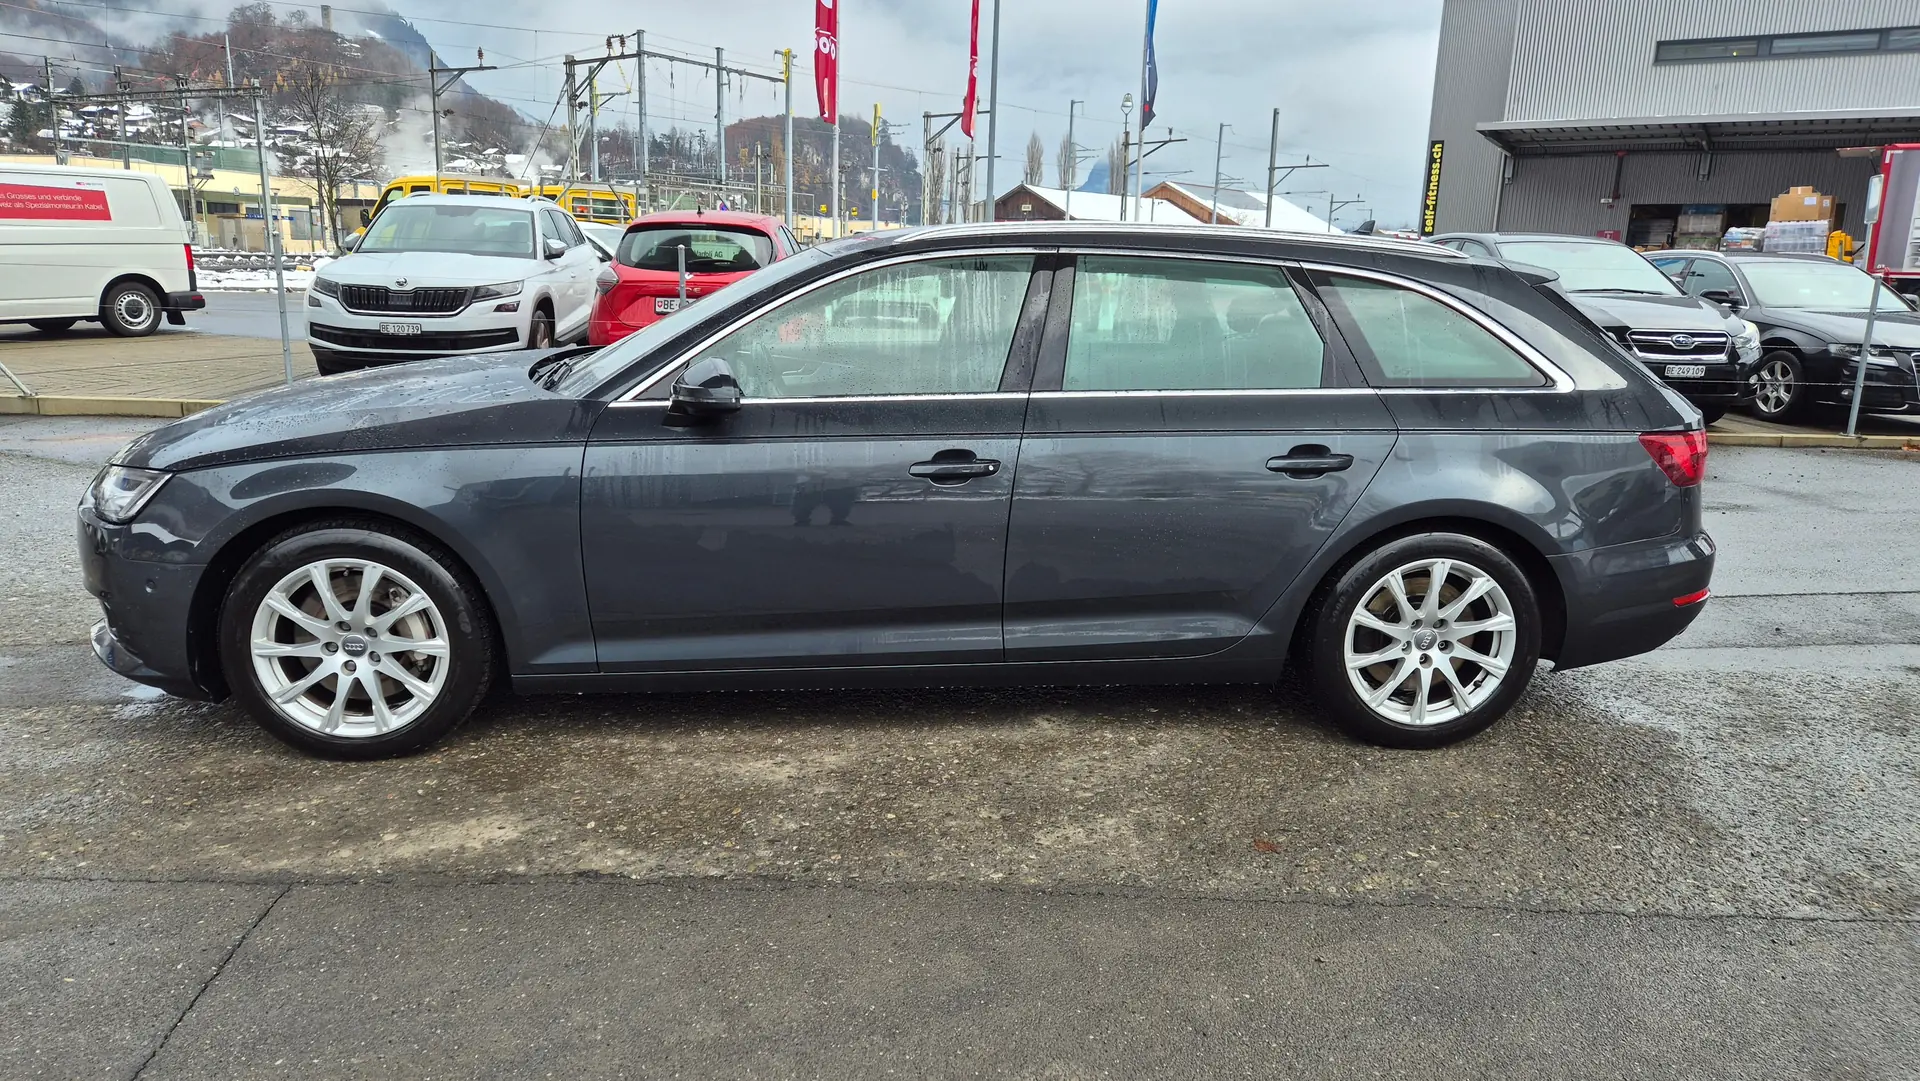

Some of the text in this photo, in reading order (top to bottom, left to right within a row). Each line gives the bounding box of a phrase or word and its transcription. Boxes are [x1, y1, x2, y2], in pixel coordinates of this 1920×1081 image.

[6, 192, 36, 200] Grosses
[53, 193, 82, 201] verbinde
[1424, 143, 1443, 233] self-fitness.ch
